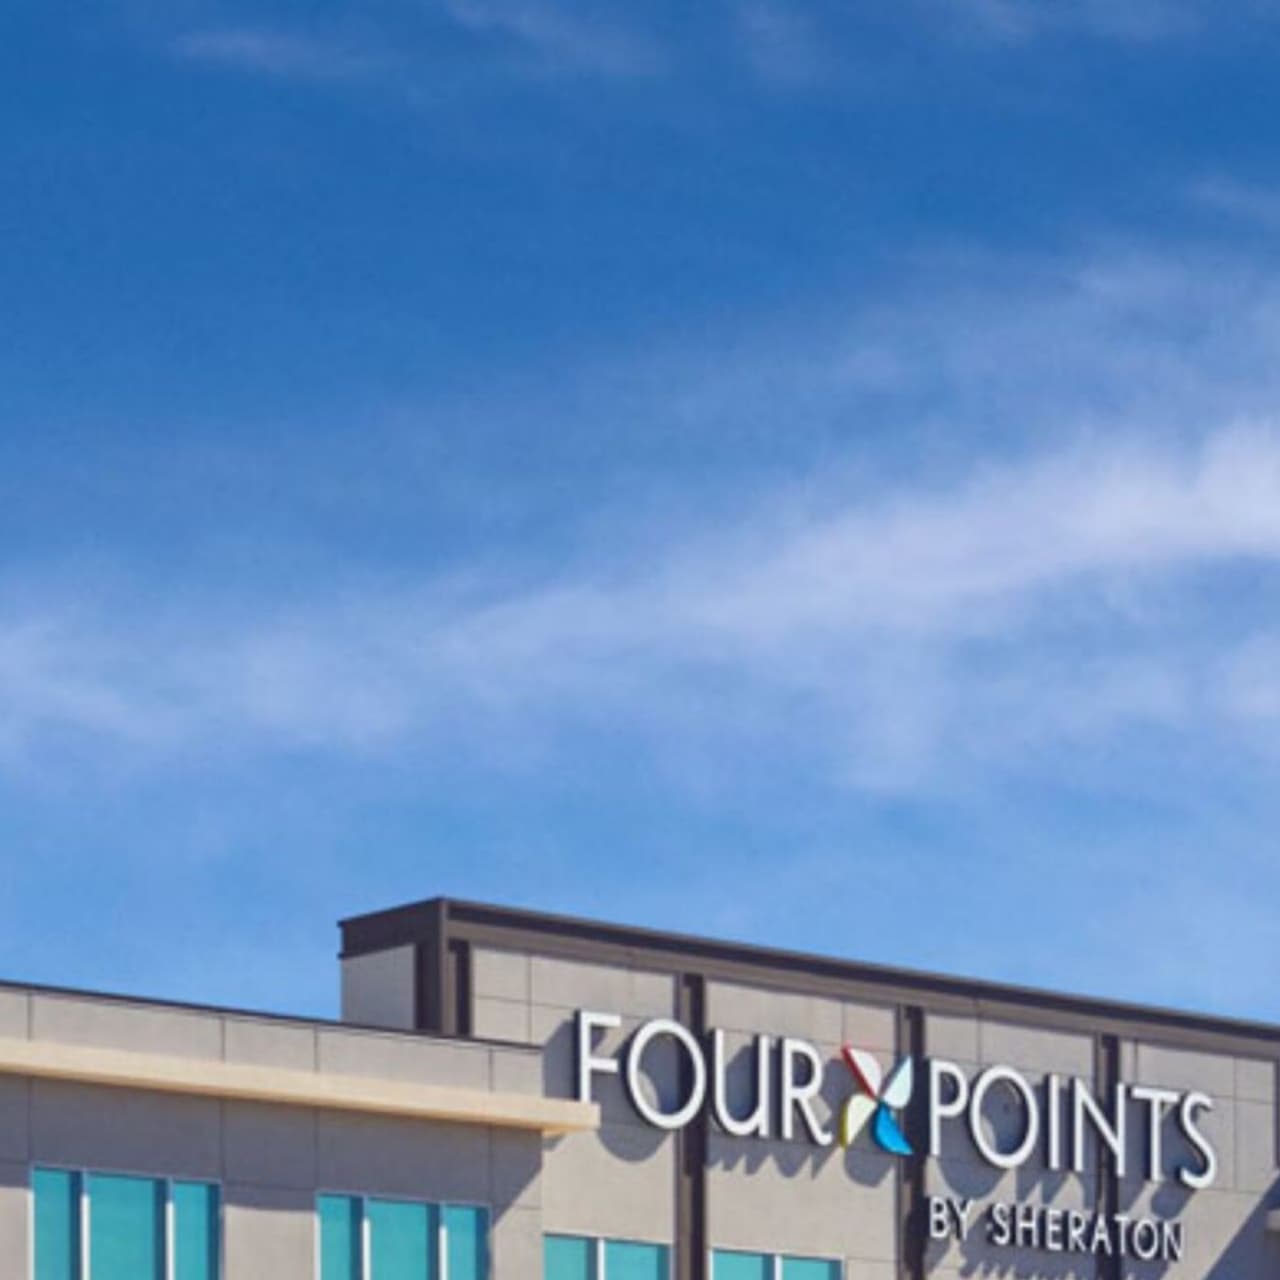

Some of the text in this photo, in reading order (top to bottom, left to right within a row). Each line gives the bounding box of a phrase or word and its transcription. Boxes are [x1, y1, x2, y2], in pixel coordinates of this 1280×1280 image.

[575, 1009, 1217, 1189] FOUR POINTS
[929, 1196, 1183, 1261] BY SHERATON
